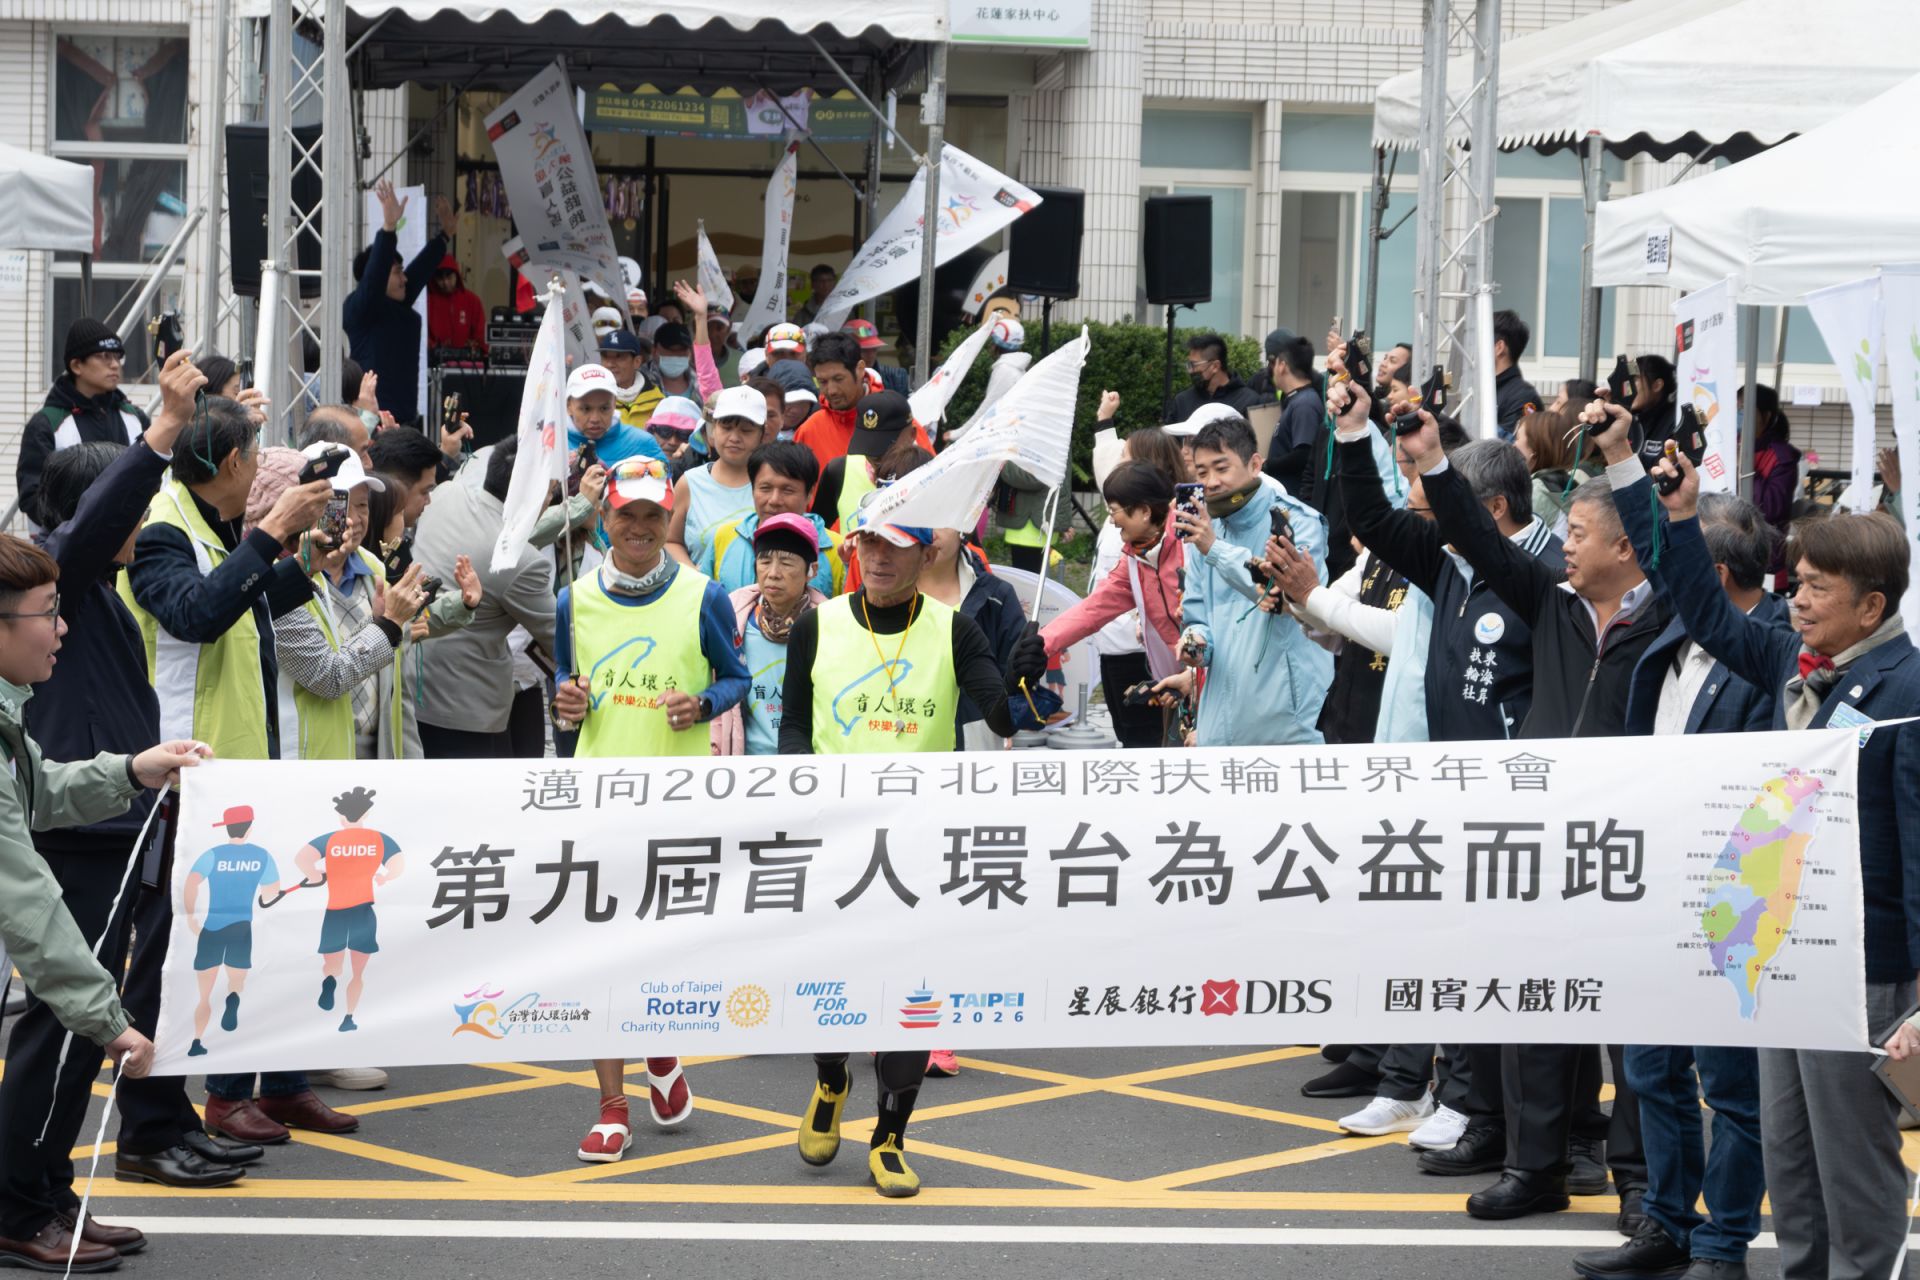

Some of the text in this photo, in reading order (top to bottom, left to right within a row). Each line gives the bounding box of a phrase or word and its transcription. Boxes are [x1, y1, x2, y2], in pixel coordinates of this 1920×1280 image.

[976, 7, 1061, 21] 花蓮家扶中心
[1462, 646, 1482, 700] 扶輪社
[1478, 649, 1498, 706] 東海岸
[855, 693, 937, 718] 盲人環台
[330, 844, 377, 858] GUIDE
[216, 859, 262, 873] BLIND
[425, 817, 1647, 930] 第九屆盲人環台為公益而跑
[640, 981, 723, 996] Club of Taipei
[796, 982, 846, 997] UNITE
[1384, 977, 1604, 1015] 國賓大戲院
[813, 997, 849, 1012] FOR
[949, 992, 1026, 1009] TAIPEI
[1067, 984, 1198, 1018] 星展銀行
[1244, 979, 1333, 1016] DBS
[646, 996, 721, 1018] Rotary
[508, 1007, 592, 1023] 台灣盲人環台協會
[817, 1012, 868, 1027] GOOD
[952, 1010, 1025, 1024] 2026
[517, 1022, 573, 1035] TBCA
[621, 1019, 720, 1034] Charity Running
